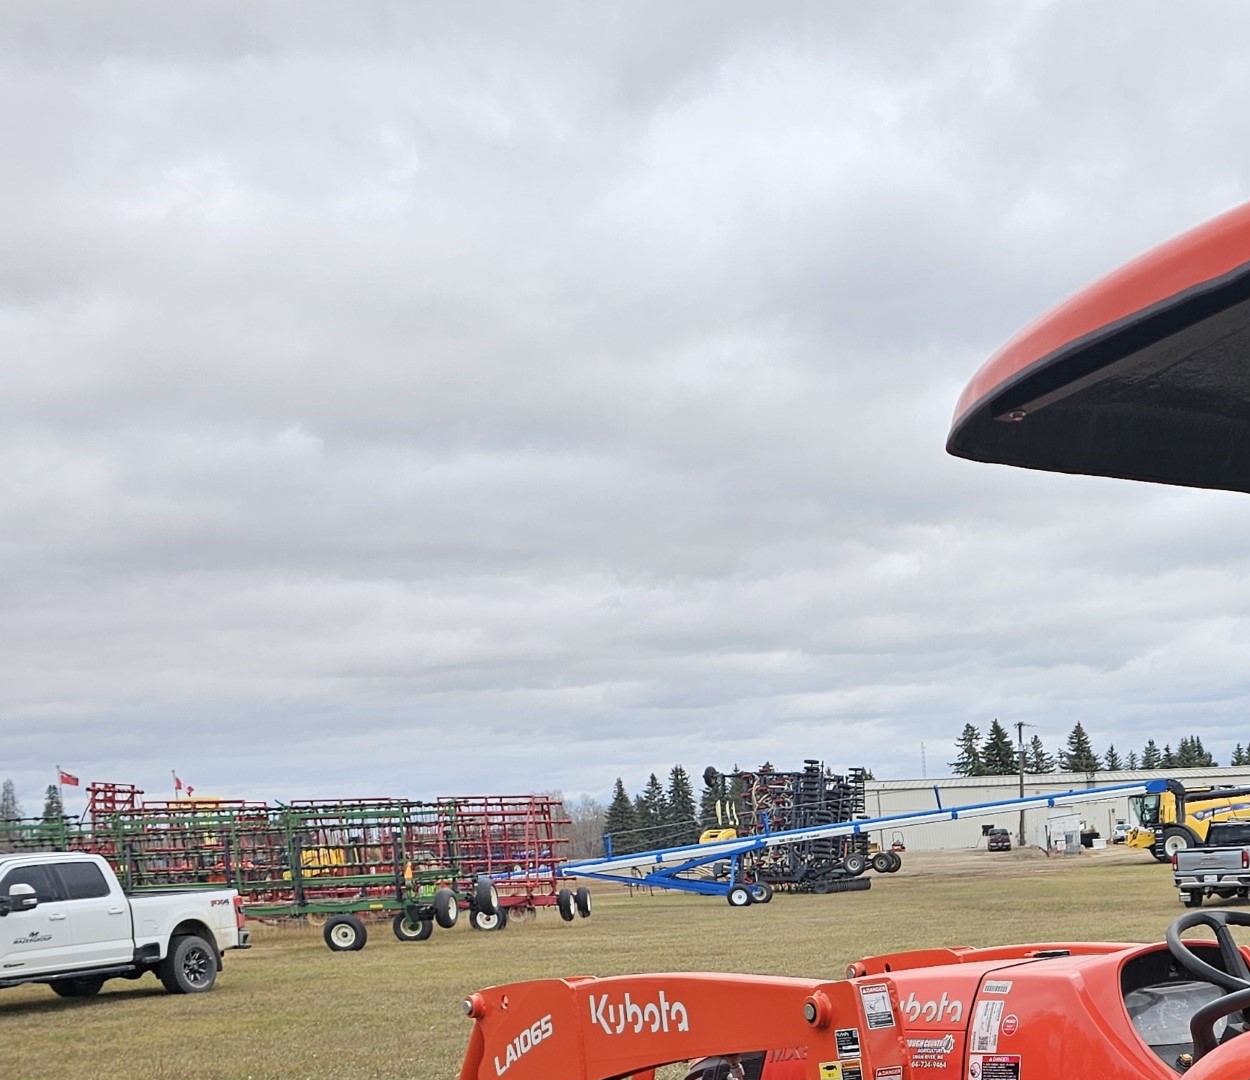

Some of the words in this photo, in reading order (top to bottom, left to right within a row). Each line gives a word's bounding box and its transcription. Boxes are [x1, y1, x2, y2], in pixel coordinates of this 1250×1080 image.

[589, 990, 689, 1035] Kubota
[494, 1014, 553, 1077] LA1065
[911, 1061, 947, 1069] 04-734-9464
